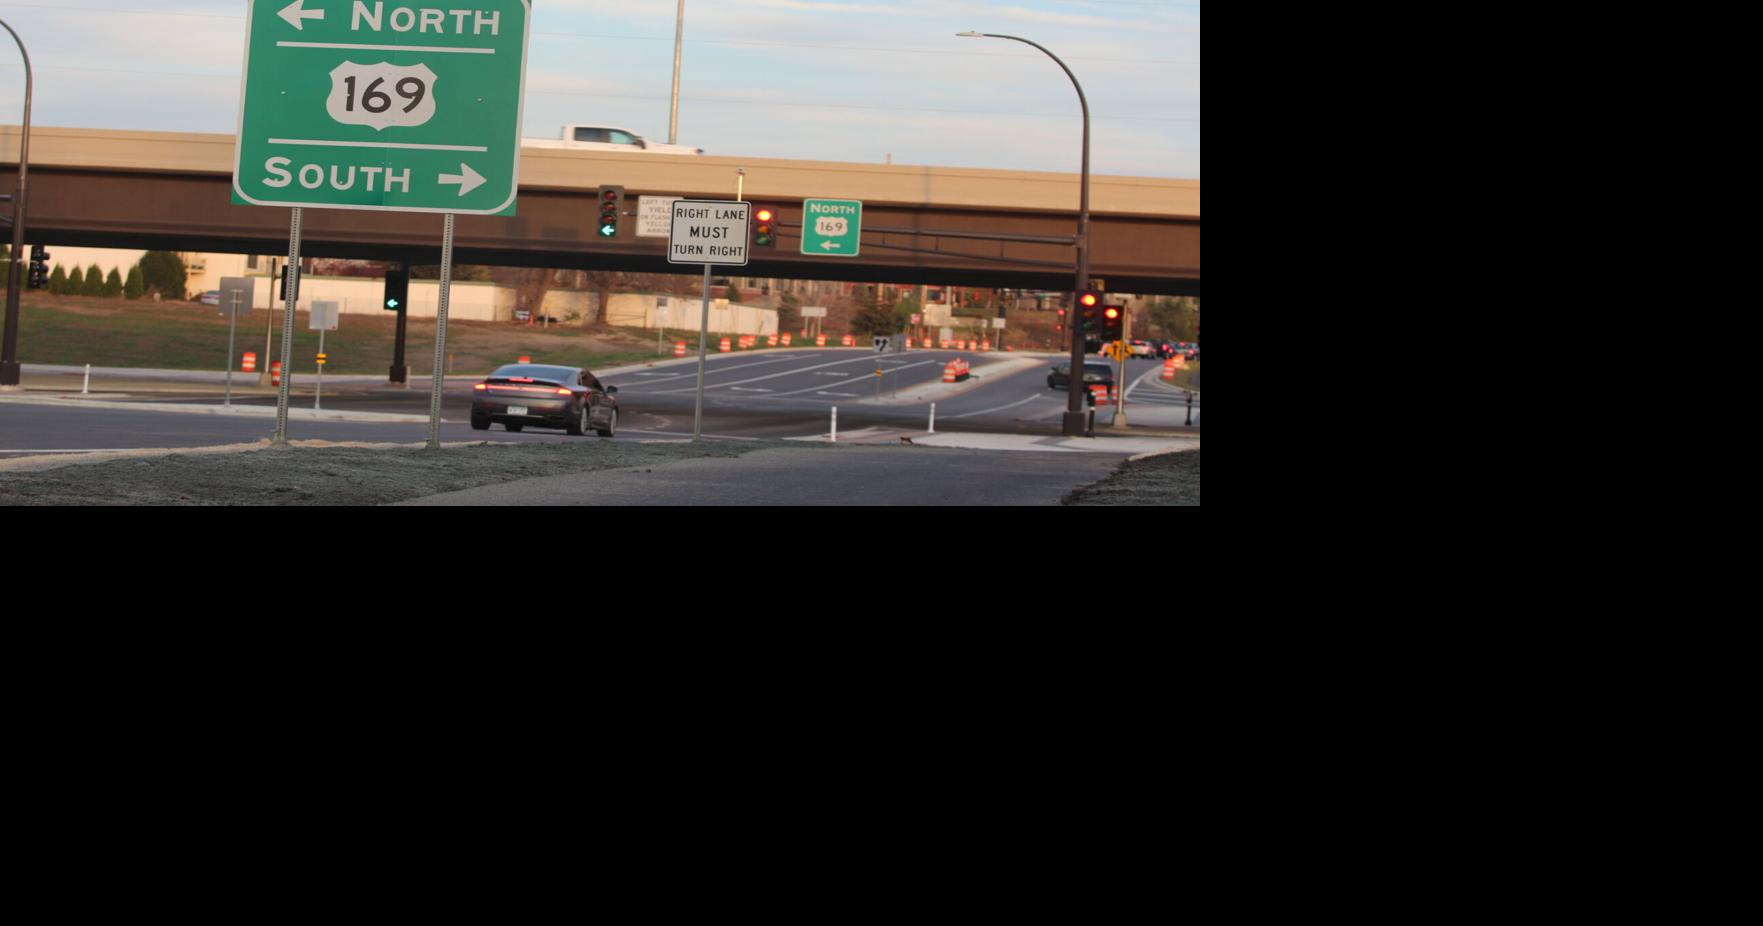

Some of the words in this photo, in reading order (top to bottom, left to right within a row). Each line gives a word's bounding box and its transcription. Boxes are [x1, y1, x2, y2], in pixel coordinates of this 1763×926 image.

[351, 1, 500, 36] NORTH
[344, 75, 426, 114] 169
[262, 156, 411, 193] SOUTH
[676, 208, 709, 219] RIGHT
[716, 209, 745, 220] LANE
[810, 203, 856, 214] NORTH
[690, 226, 729, 239] MUST
[820, 221, 843, 232] 169
[674, 244, 703, 255] TURN
[710, 245, 743, 256] RIGHT
